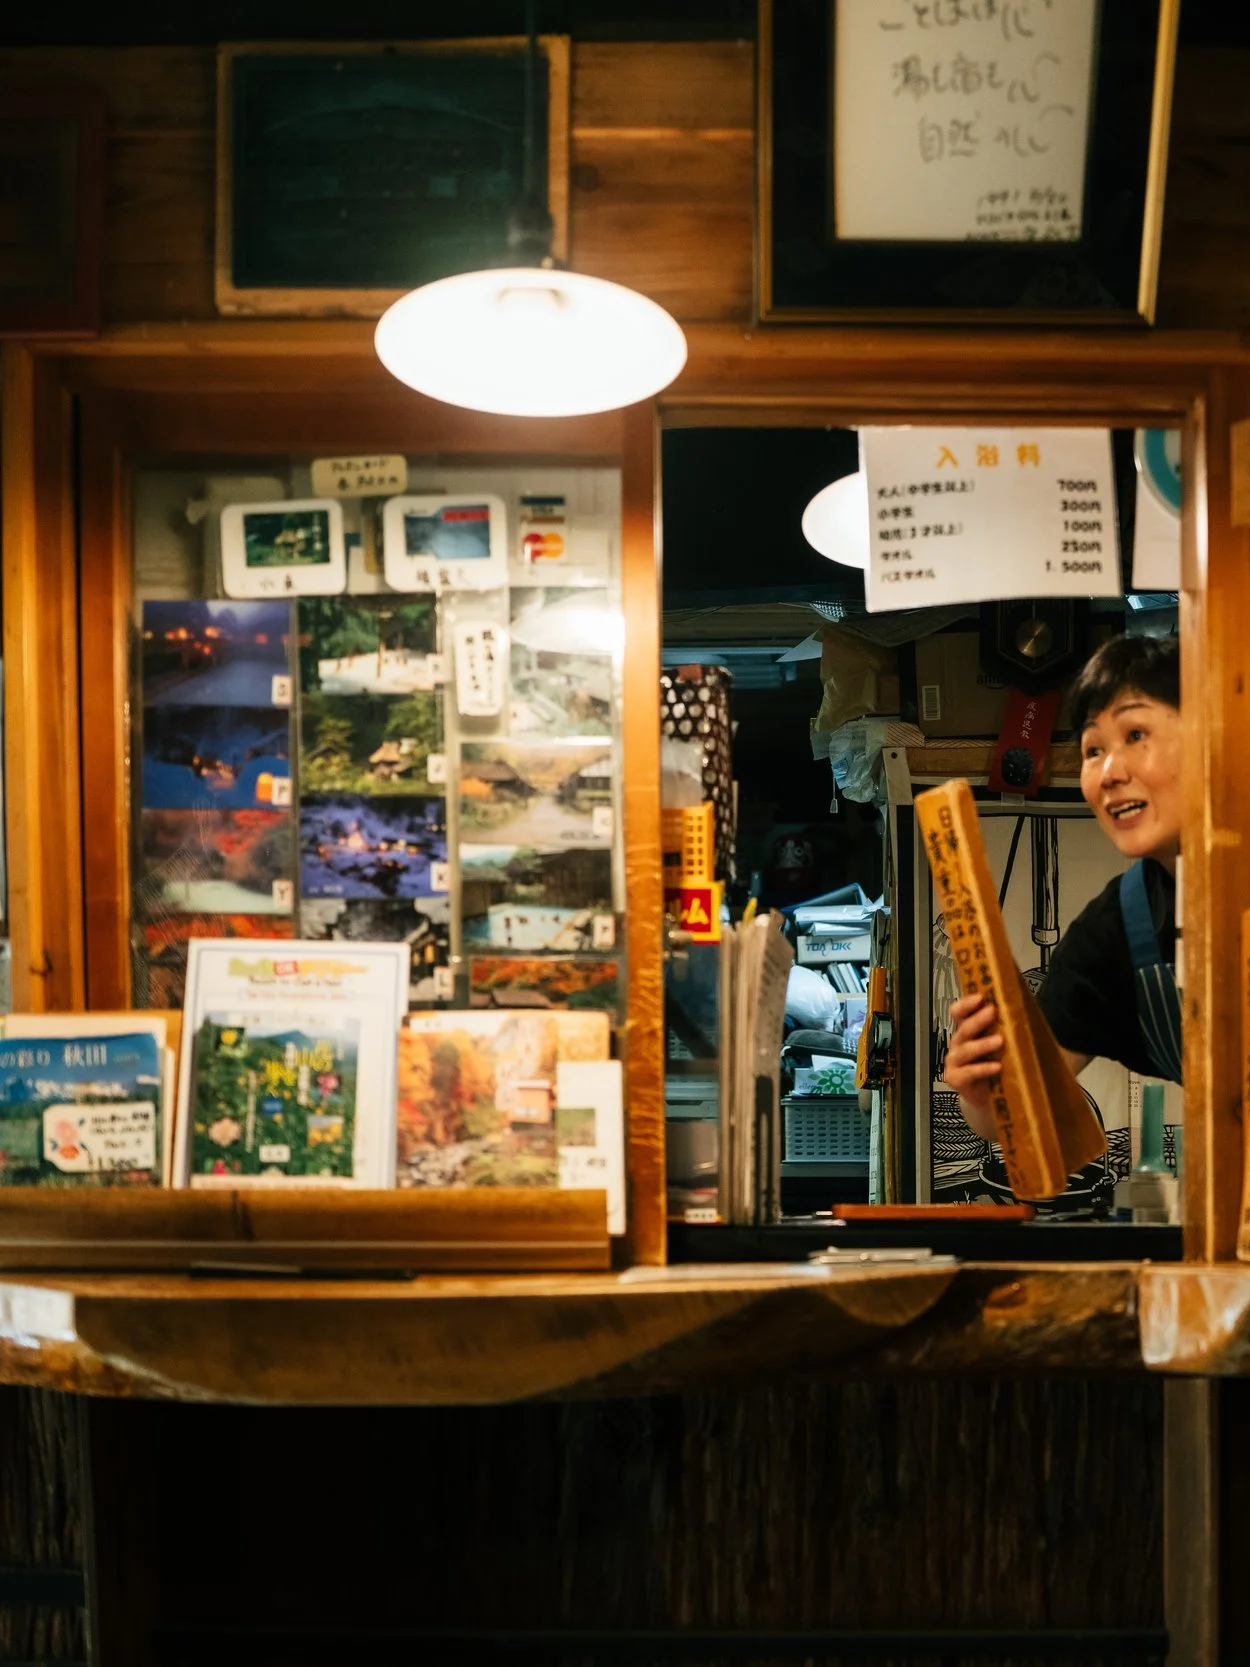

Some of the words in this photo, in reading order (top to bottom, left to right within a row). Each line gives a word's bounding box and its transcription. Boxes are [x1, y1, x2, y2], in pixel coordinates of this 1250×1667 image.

[935, 443, 1041, 469] 入浴料
[1057, 479, 1098, 494] 700円
[877, 505, 914, 520] 小学生
[1060, 499, 1102, 514] 300円
[1063, 519, 1102, 534] 100円
[880, 549, 912, 562] タオル
[1060, 540, 1102, 555] 250円
